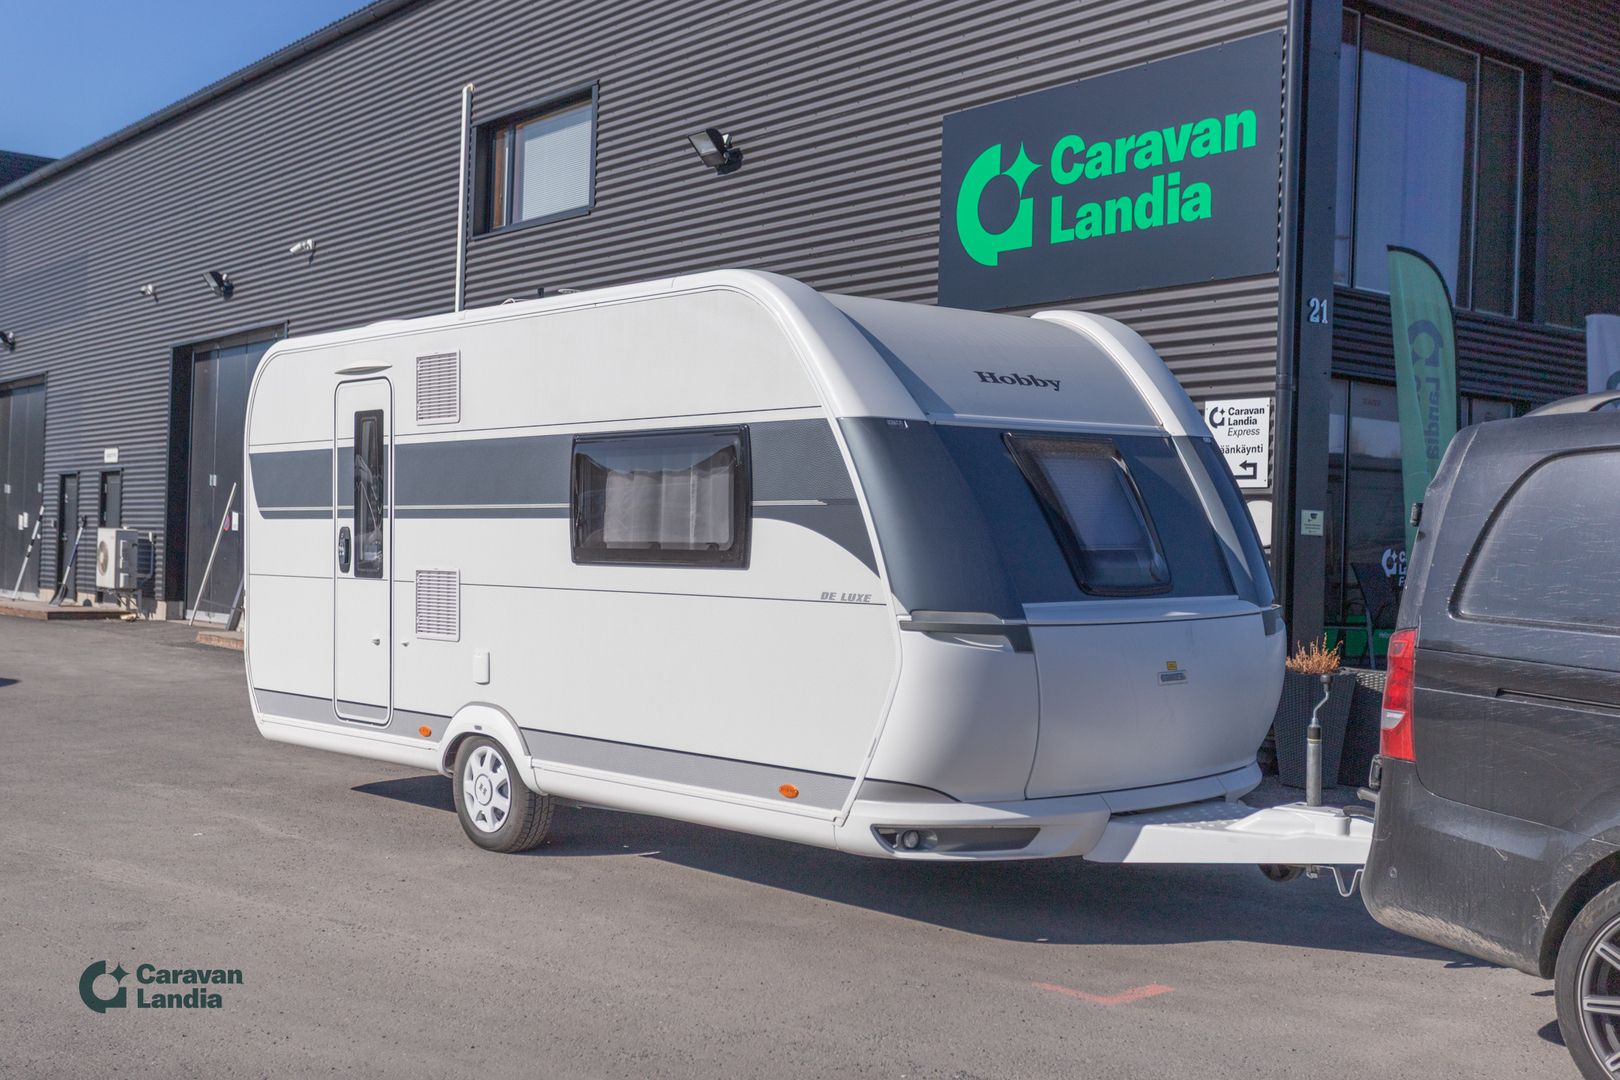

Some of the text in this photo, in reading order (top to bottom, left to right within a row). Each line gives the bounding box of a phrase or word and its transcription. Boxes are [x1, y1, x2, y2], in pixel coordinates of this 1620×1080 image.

[1050, 108, 1257, 186] Caravan
[1049, 171, 1212, 245] Landia
[1309, 297, 1329, 324] 21
[973, 370, 1061, 392] Hobby
[1227, 406, 1265, 416] Caravan
[1227, 416, 1258, 426] Landia
[1227, 427, 1261, 438] Express
[1219, 443, 1264, 456] äänkäynti
[820, 591, 872, 603] DE LUXE
